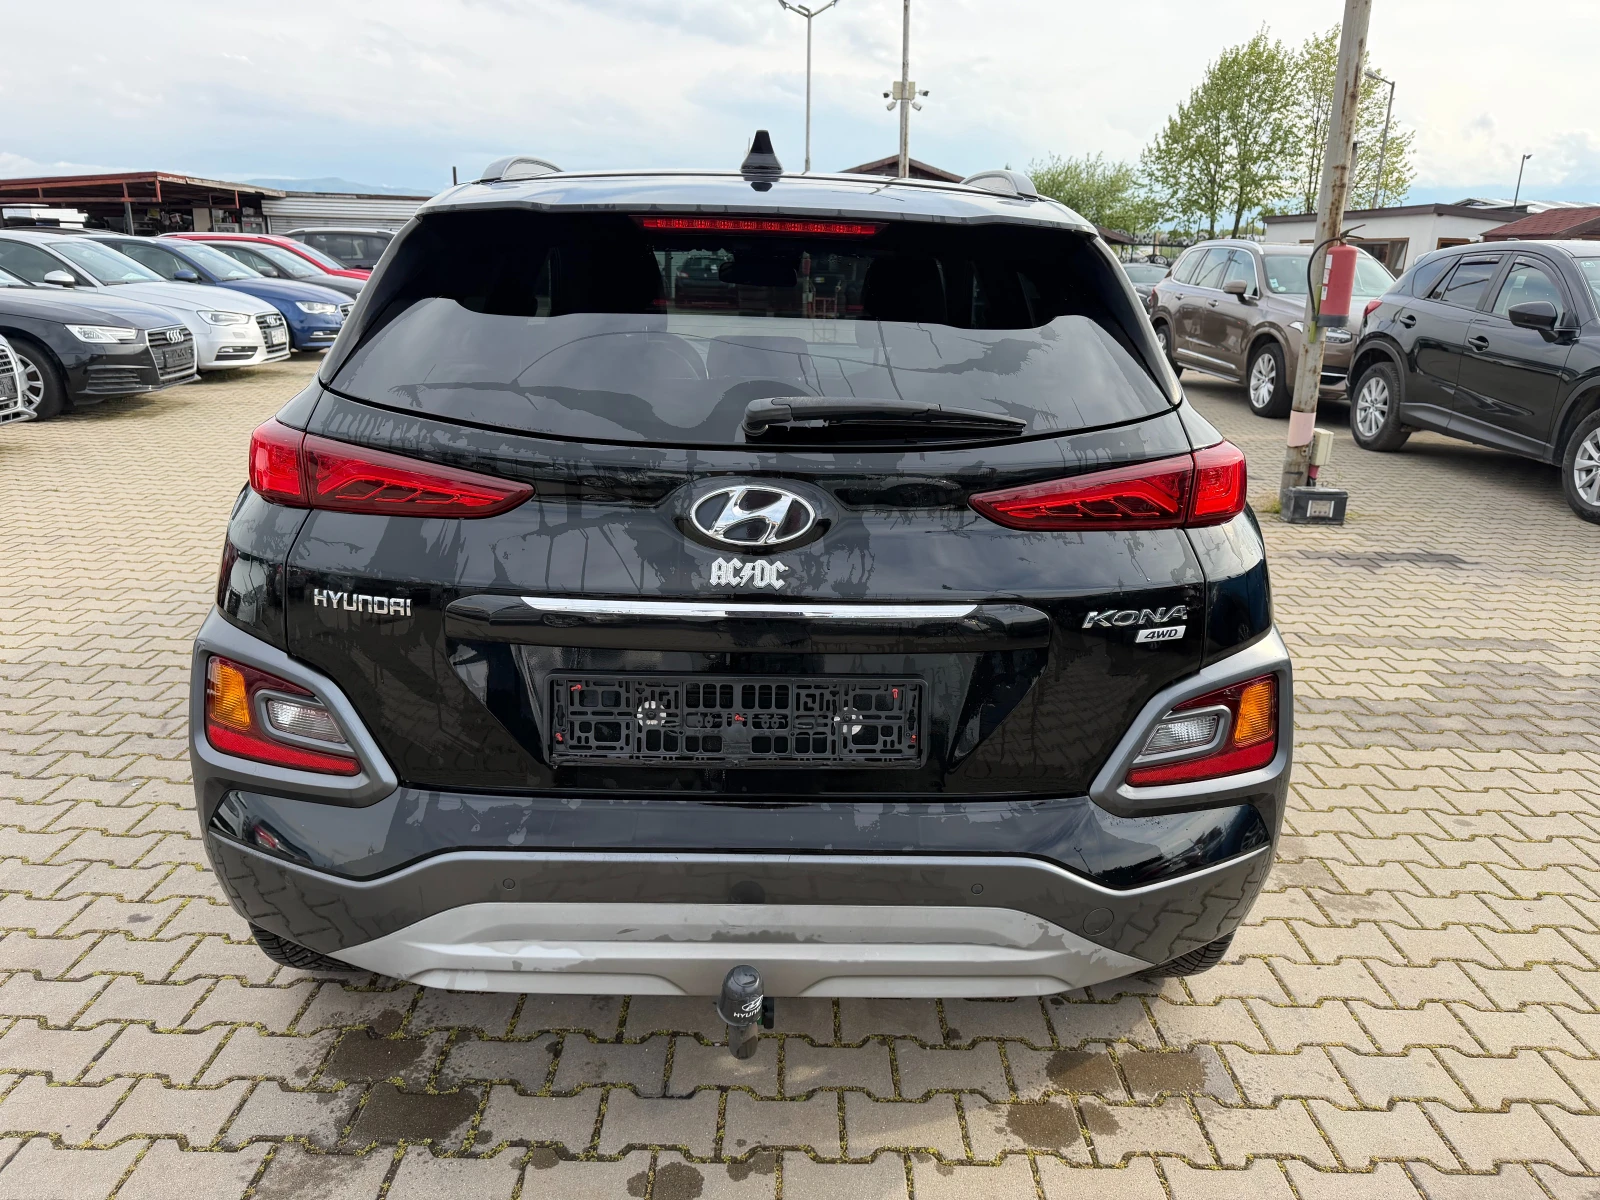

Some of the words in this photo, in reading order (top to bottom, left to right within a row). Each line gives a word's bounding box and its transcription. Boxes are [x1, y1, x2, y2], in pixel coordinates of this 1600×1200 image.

[313, 588, 412, 616] HYUNDAI
[1081, 604, 1188, 629] KONA
[1143, 628, 1179, 640] 4WD
